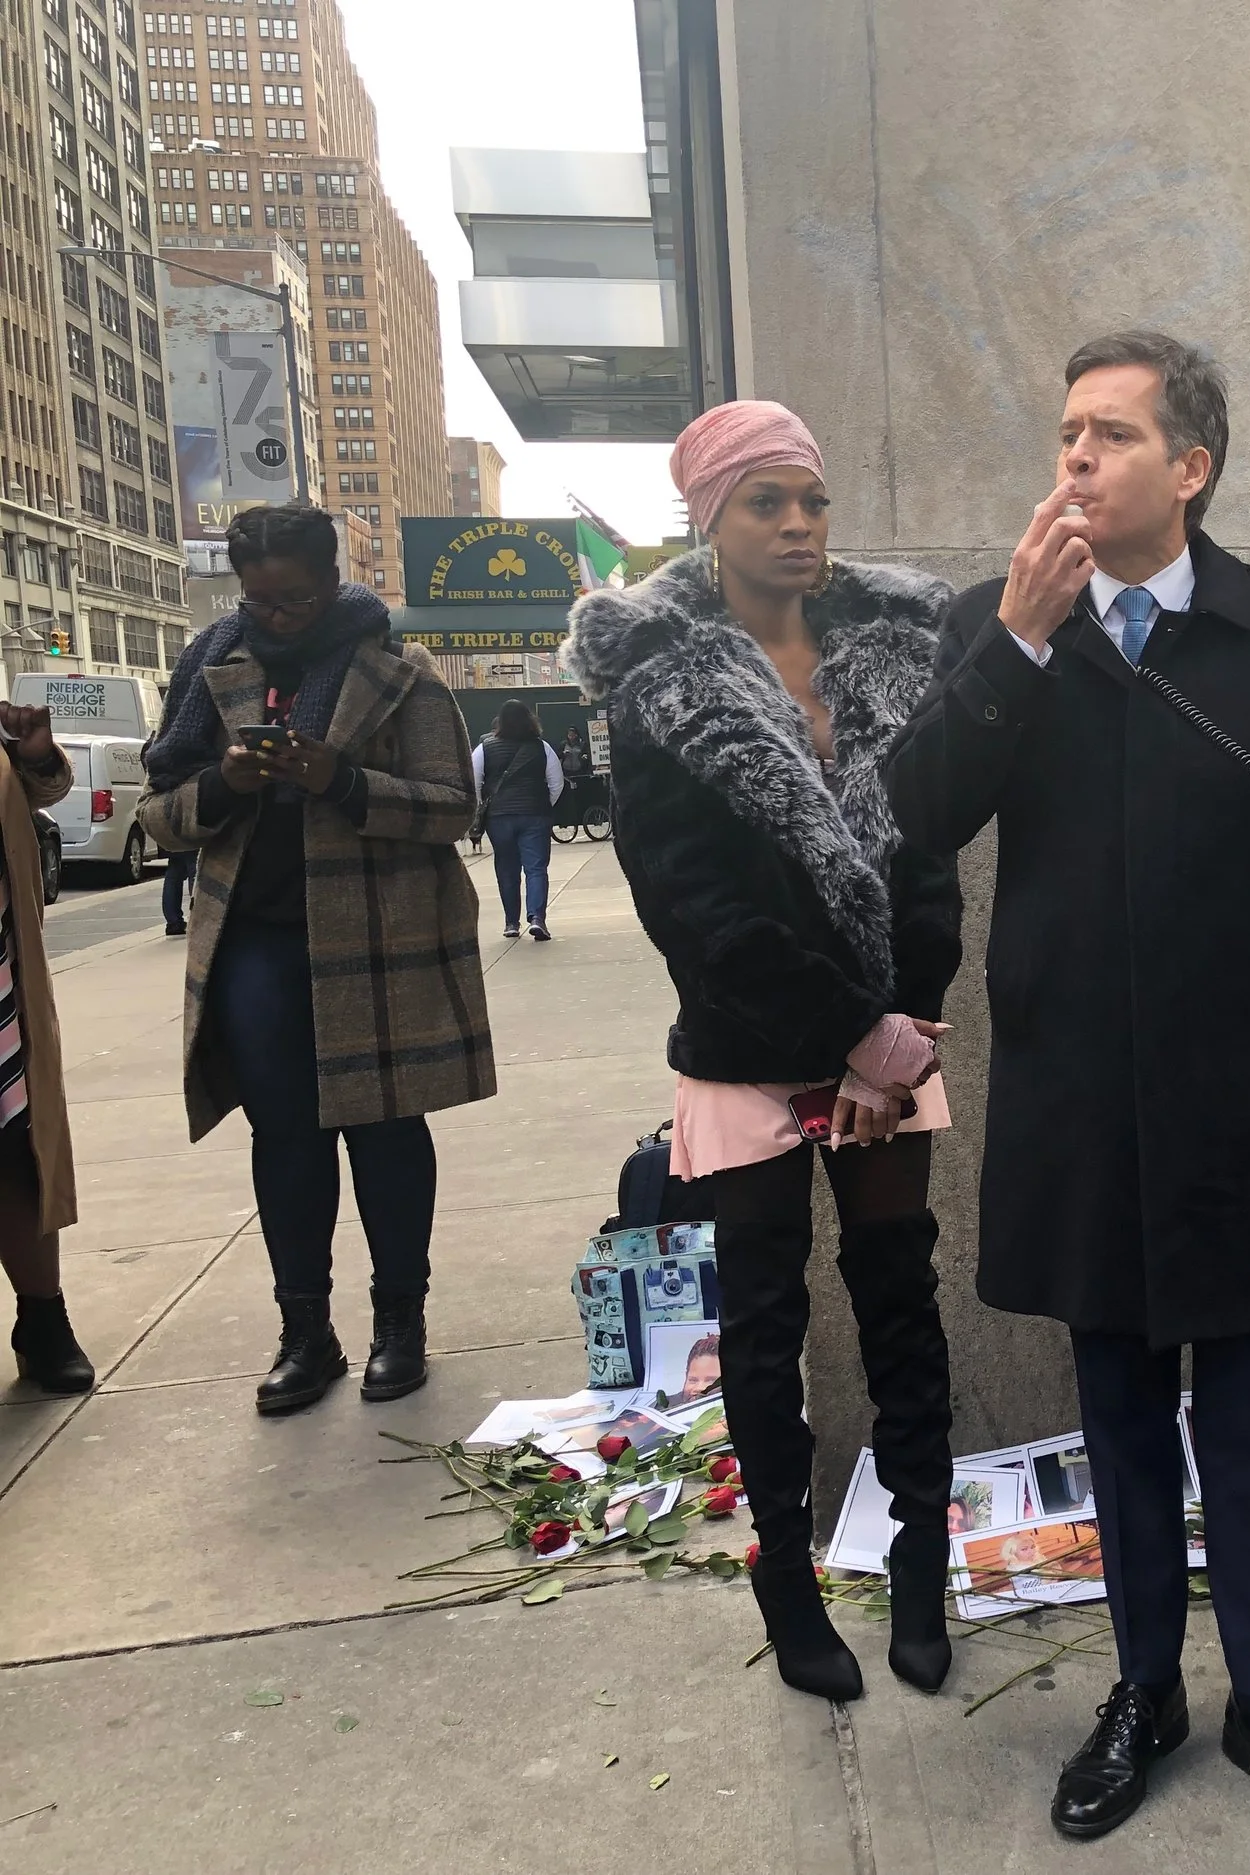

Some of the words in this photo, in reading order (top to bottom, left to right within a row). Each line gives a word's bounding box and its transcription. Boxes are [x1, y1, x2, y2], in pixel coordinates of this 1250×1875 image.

[262, 446, 280, 459] FIT
[429, 555, 452, 599] THE
[448, 522, 528, 553] TRIPLE
[448, 590, 484, 599] IRISH
[488, 590, 514, 599] BAR
[518, 590, 527, 598] &
[531, 590, 569, 598] GRILL
[402, 633, 444, 647] THE
[450, 633, 523, 647] TRIPLE
[529, 632, 570, 647] CRO
[46, 682, 105, 694] INTERIOR
[46, 693, 106, 705] FOLIAGE
[48, 705, 97, 716] DESIGN
